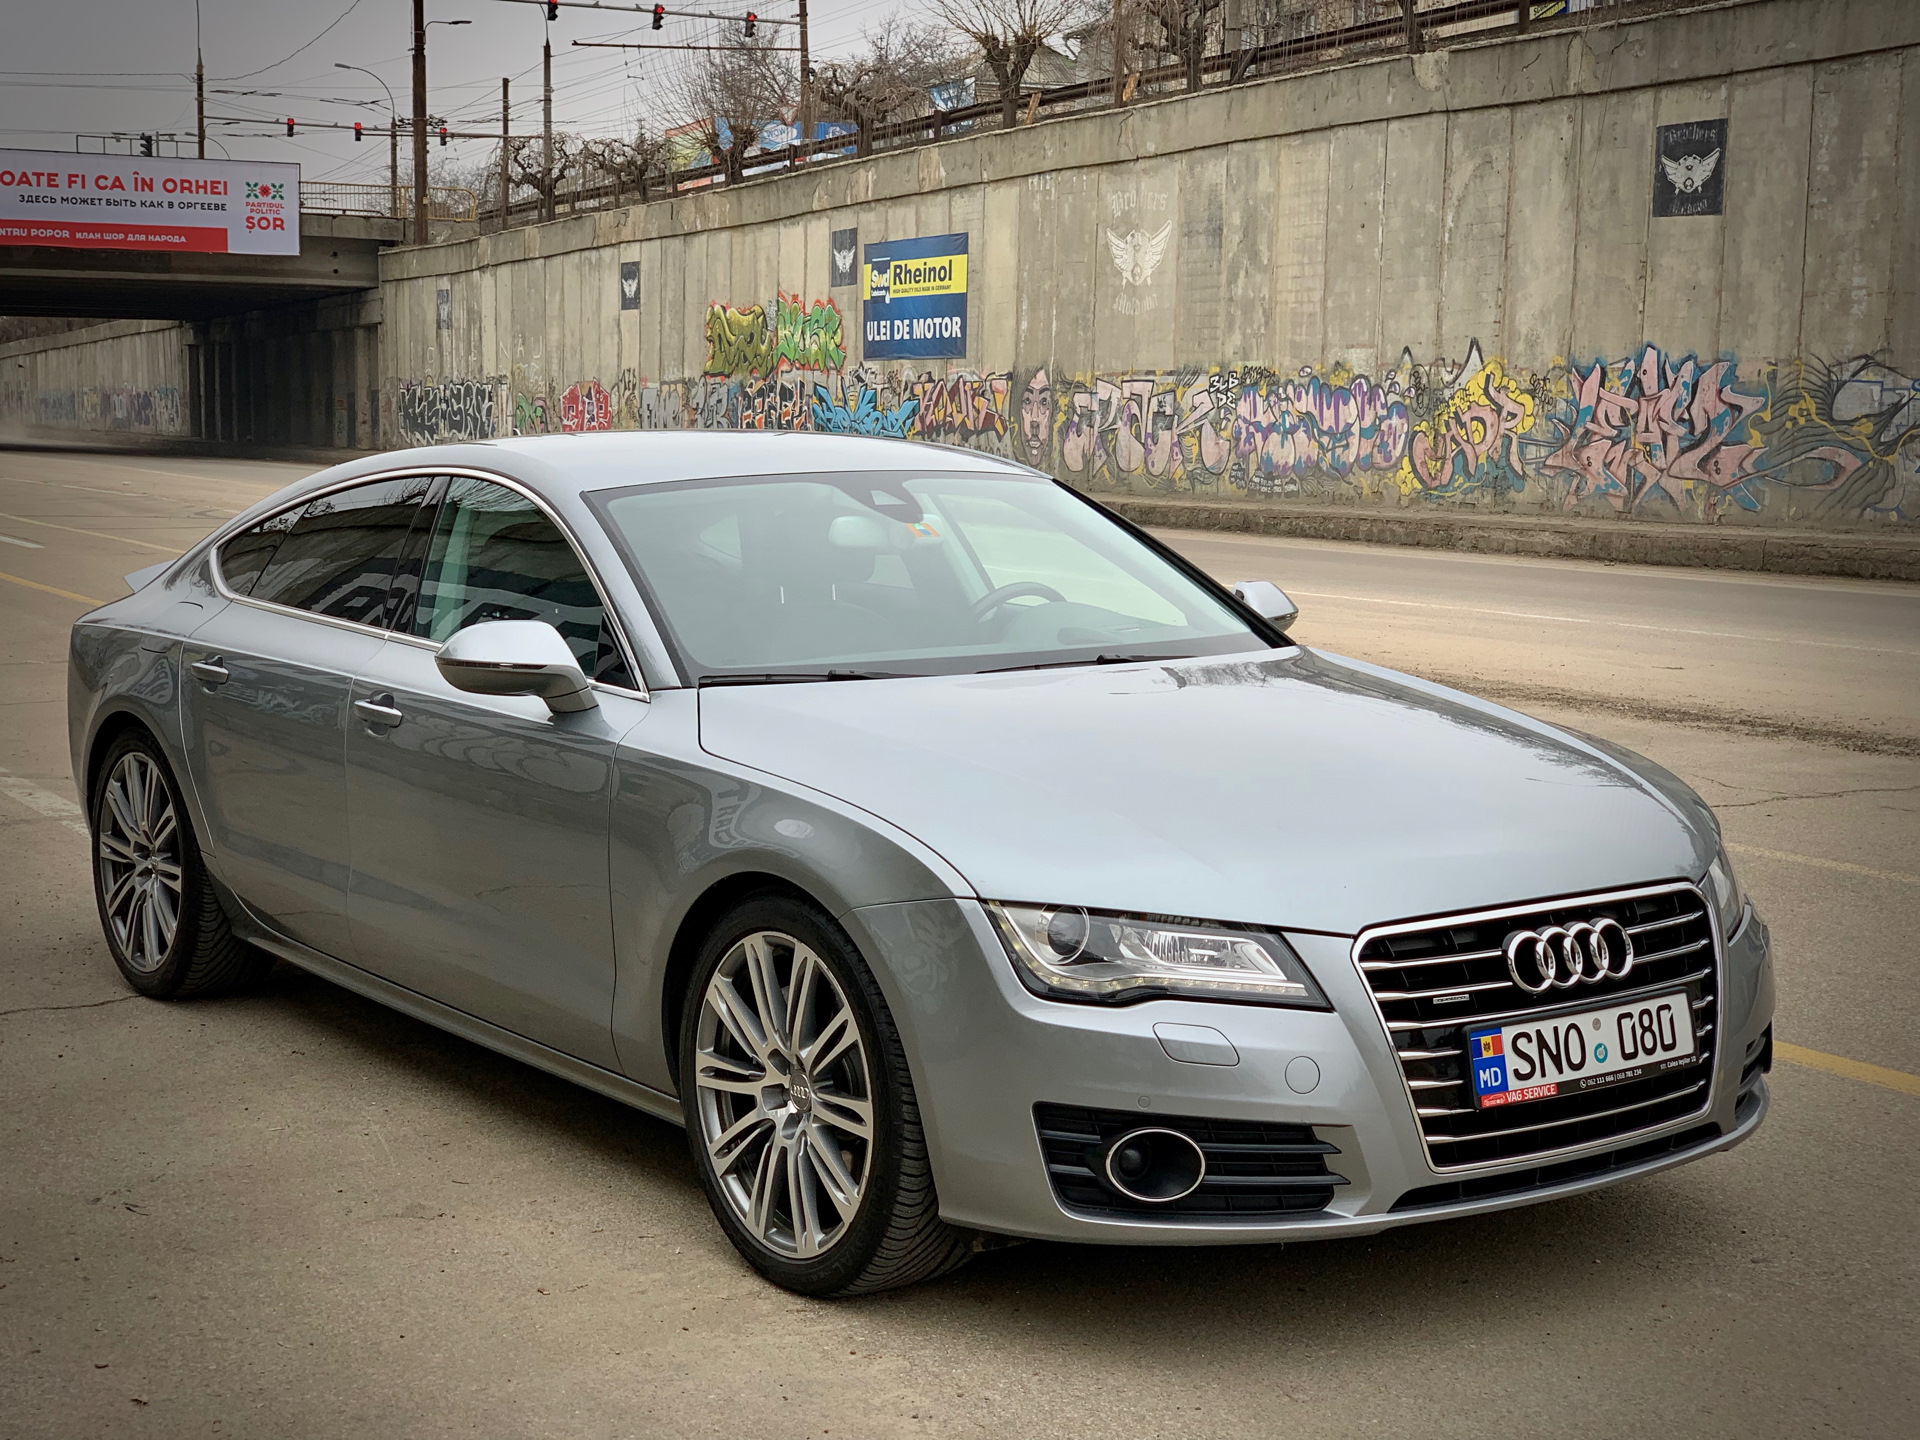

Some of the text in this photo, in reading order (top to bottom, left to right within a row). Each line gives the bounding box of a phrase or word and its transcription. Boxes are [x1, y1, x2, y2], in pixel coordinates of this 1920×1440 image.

[67, 173, 86, 190] FI
[94, 174, 126, 191] CA
[132, 170, 154, 192] ÎN
[162, 177, 228, 196] ORHEI
[19, 194, 227, 211] ЗДЕСЬ МОЖЕТ БЫТЬ КАК В ОРГЕЕВЕ
[245, 201, 285, 209] PARTIDUL
[30, 228, 70, 239] POPOR
[245, 215, 285, 234] ȘOR
[75, 232, 188, 243] ИЛАН ШОР ДЛЯ НАРОДА
[893, 259, 953, 286] Rheinol
[866, 316, 962, 341] ULEI DE MOTOR
[1511, 1003, 1677, 1081] SNO 080
[1479, 1067, 1502, 1089] MD
[1506, 1083, 1556, 1103] VAG SERVICE
